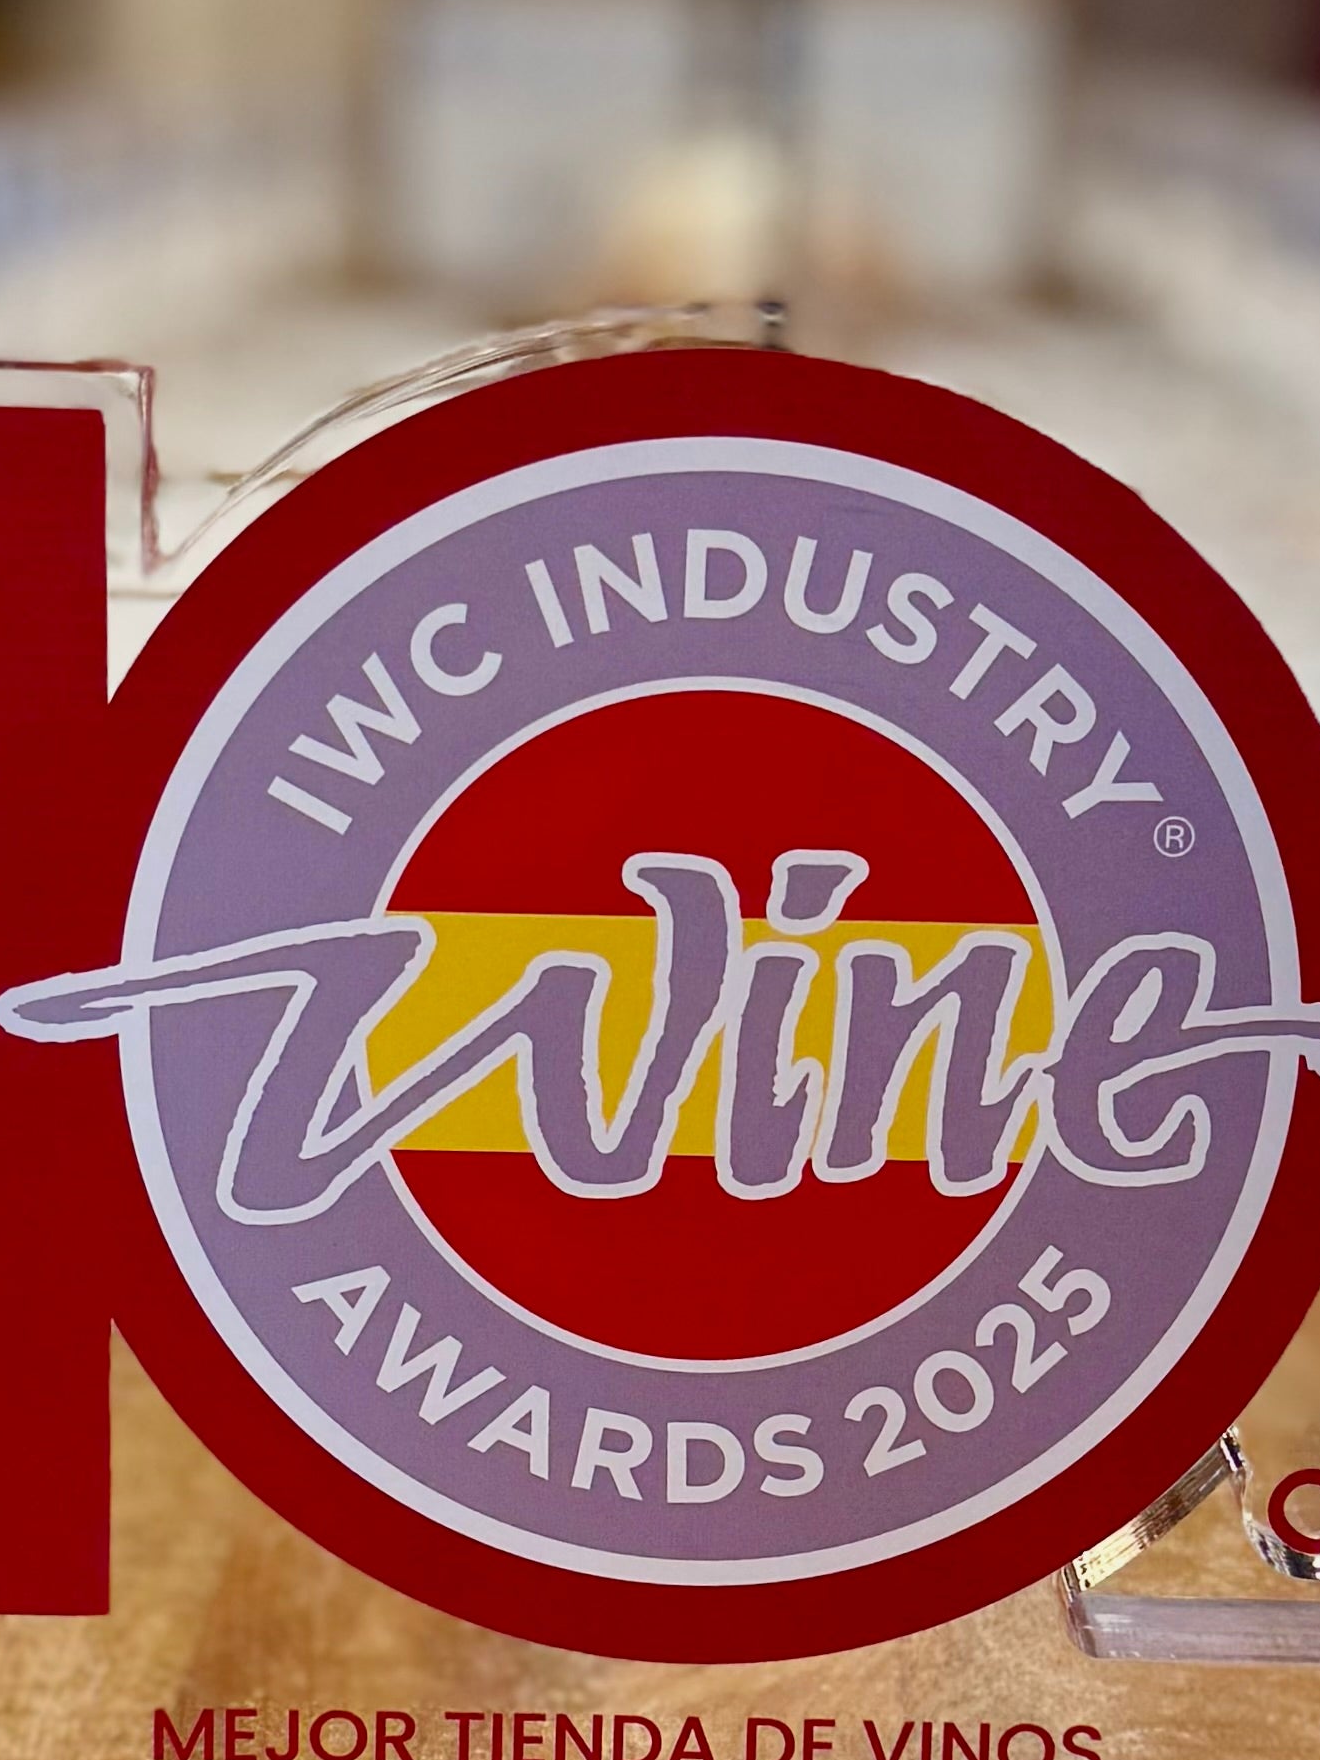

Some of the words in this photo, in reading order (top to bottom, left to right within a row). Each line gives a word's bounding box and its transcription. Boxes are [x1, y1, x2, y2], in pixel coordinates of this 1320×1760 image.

[267, 602, 504, 836] IWC
[524, 528, 1165, 821] INDUSTRY
[290, 1264, 827, 1505] AWARDS
[842, 1243, 1113, 1479] 2025
